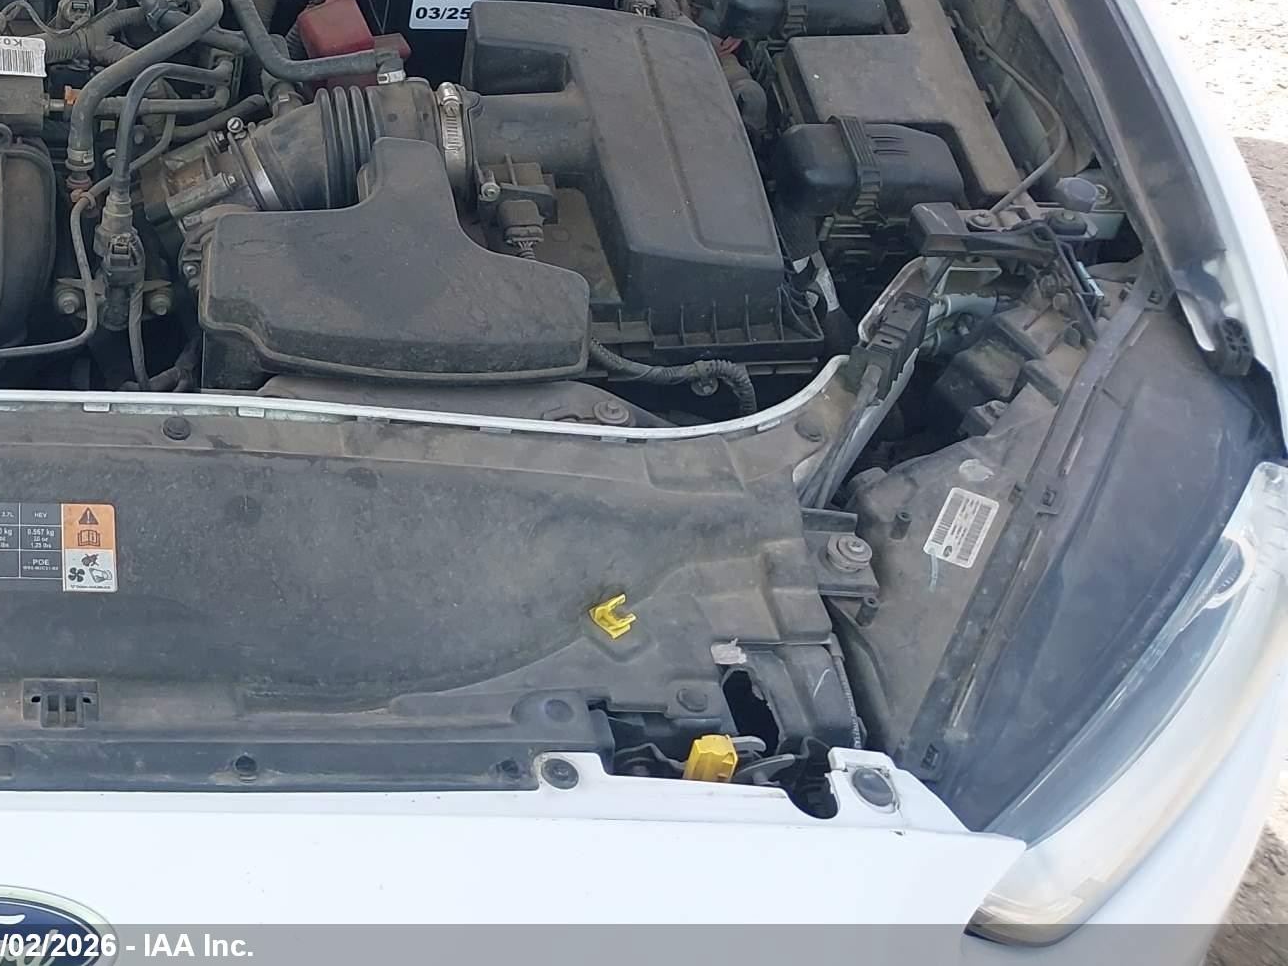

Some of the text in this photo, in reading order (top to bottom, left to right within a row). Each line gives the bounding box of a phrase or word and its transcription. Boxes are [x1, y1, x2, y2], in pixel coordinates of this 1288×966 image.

[415, 6, 470, 19] 03/25
[4, 528, 13, 536] kg
[46, 529, 55, 537] kg
